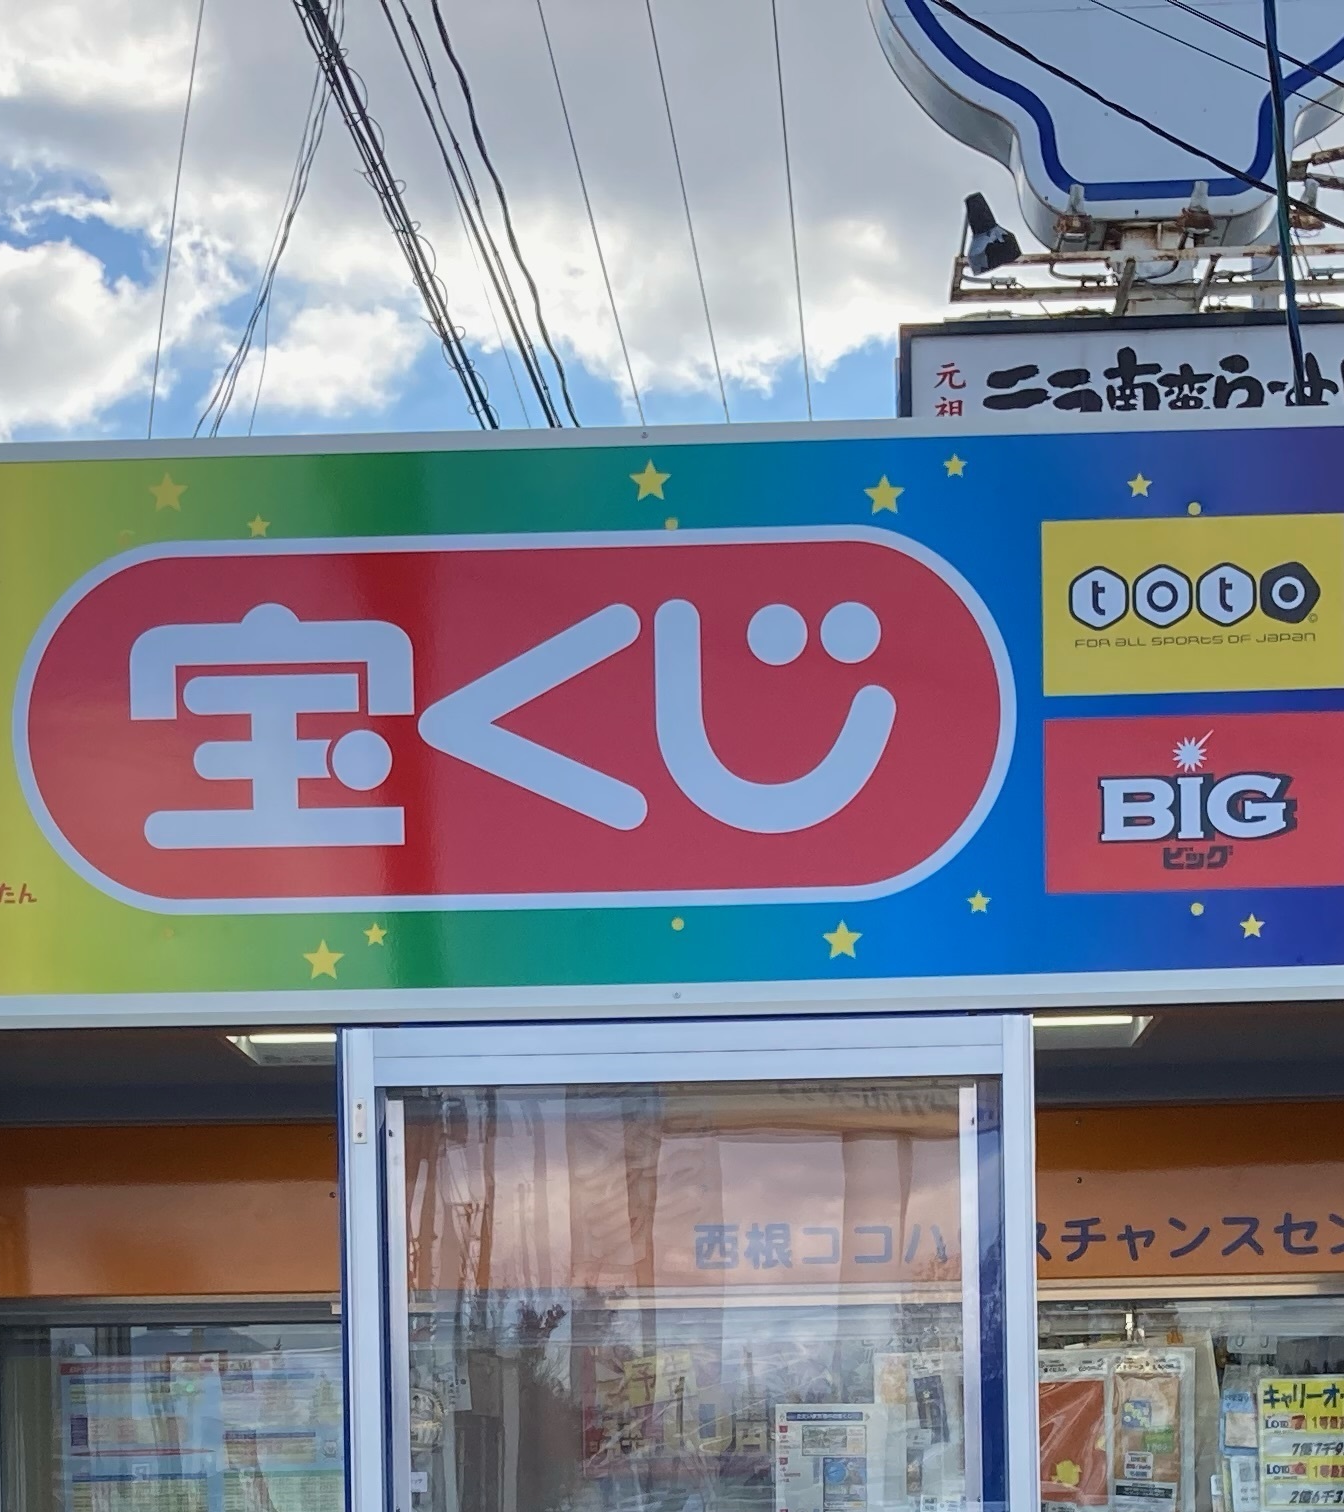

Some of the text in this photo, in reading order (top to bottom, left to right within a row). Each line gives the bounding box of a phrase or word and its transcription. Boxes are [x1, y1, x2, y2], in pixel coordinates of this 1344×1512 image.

[1068, 560, 1321, 631] toto
[129, 599, 896, 849] 宝くじ
[1098, 772, 1297, 843] BIG
[1162, 845, 1233, 870] ビッグ
